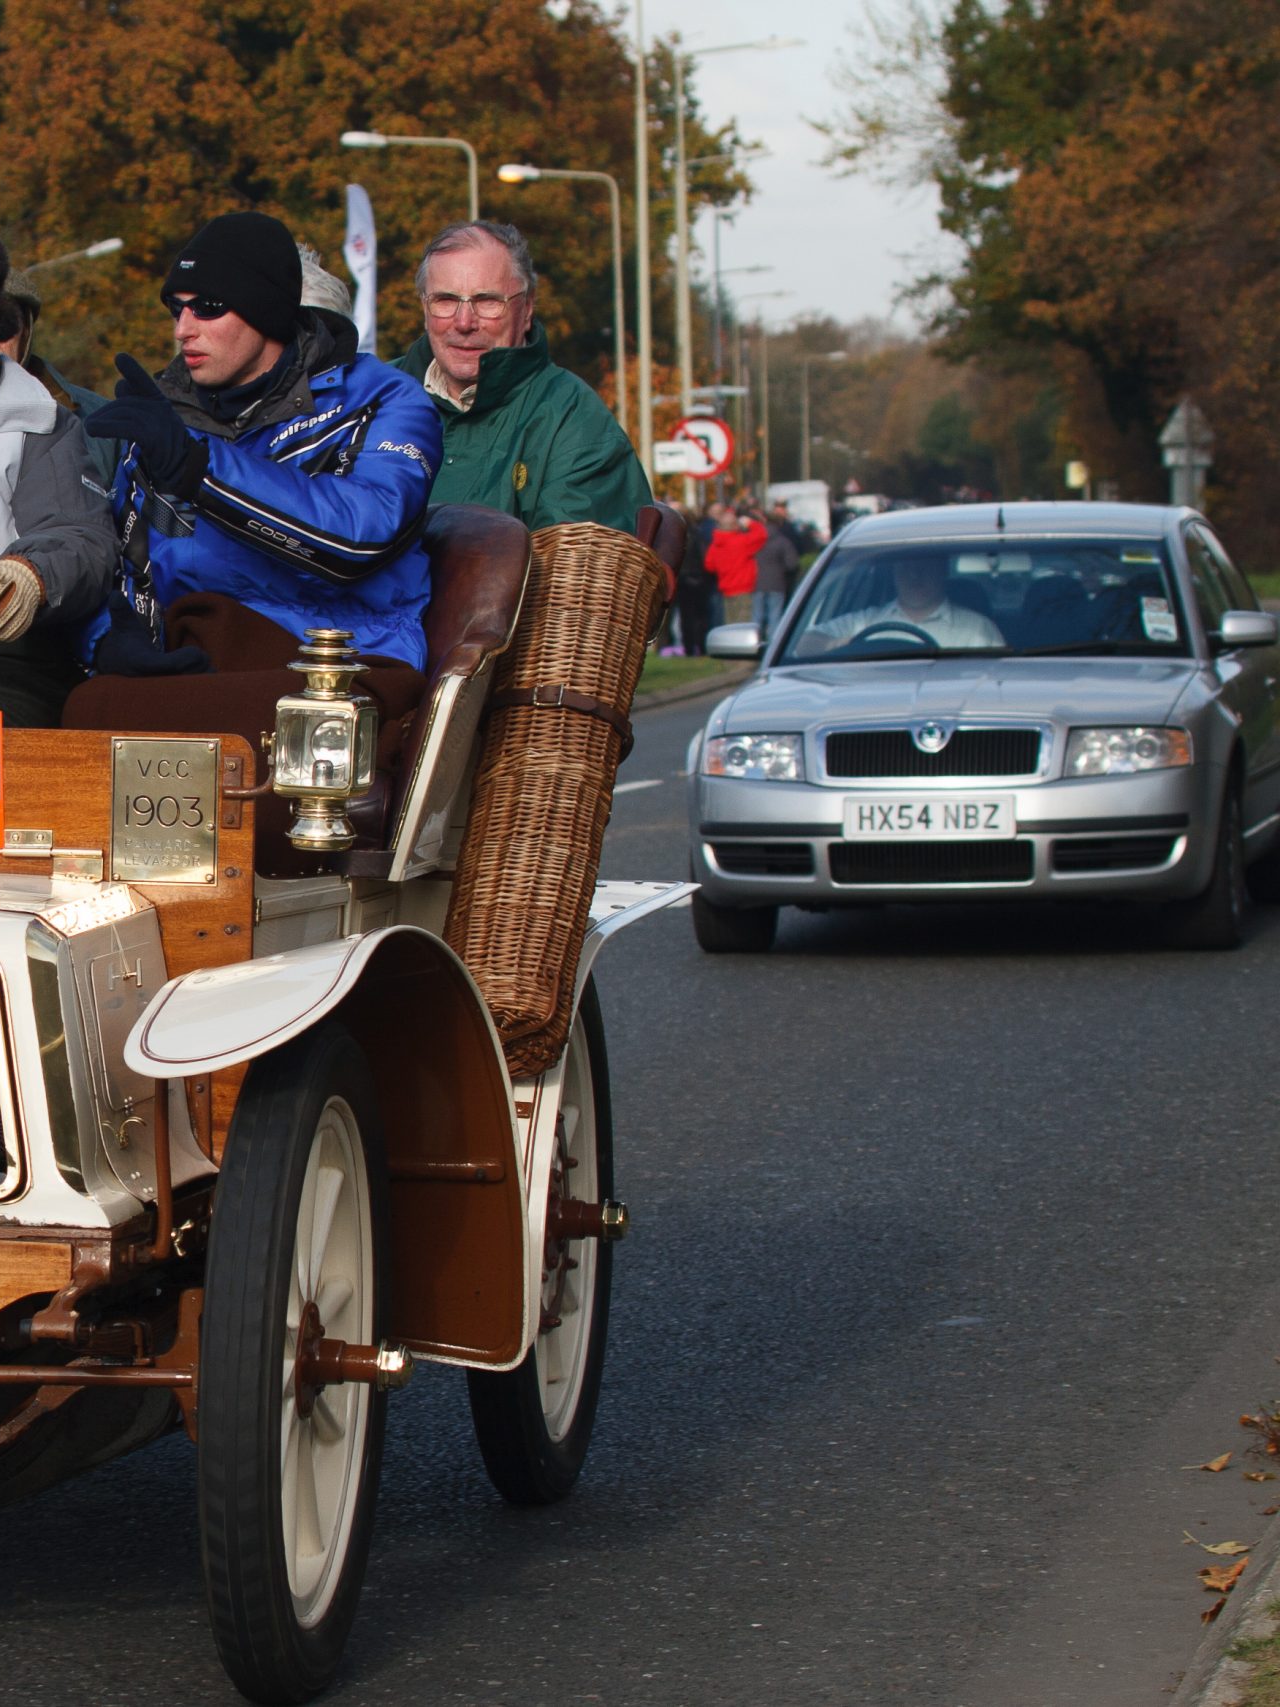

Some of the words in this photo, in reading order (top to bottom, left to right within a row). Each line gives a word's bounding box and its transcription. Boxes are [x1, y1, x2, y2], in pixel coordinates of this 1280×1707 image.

[125, 795, 204, 828] 1903
[858, 803, 932, 831] HX54
[943, 803, 1000, 830] NBZ
[125, 854, 201, 867] LEVASSOR
